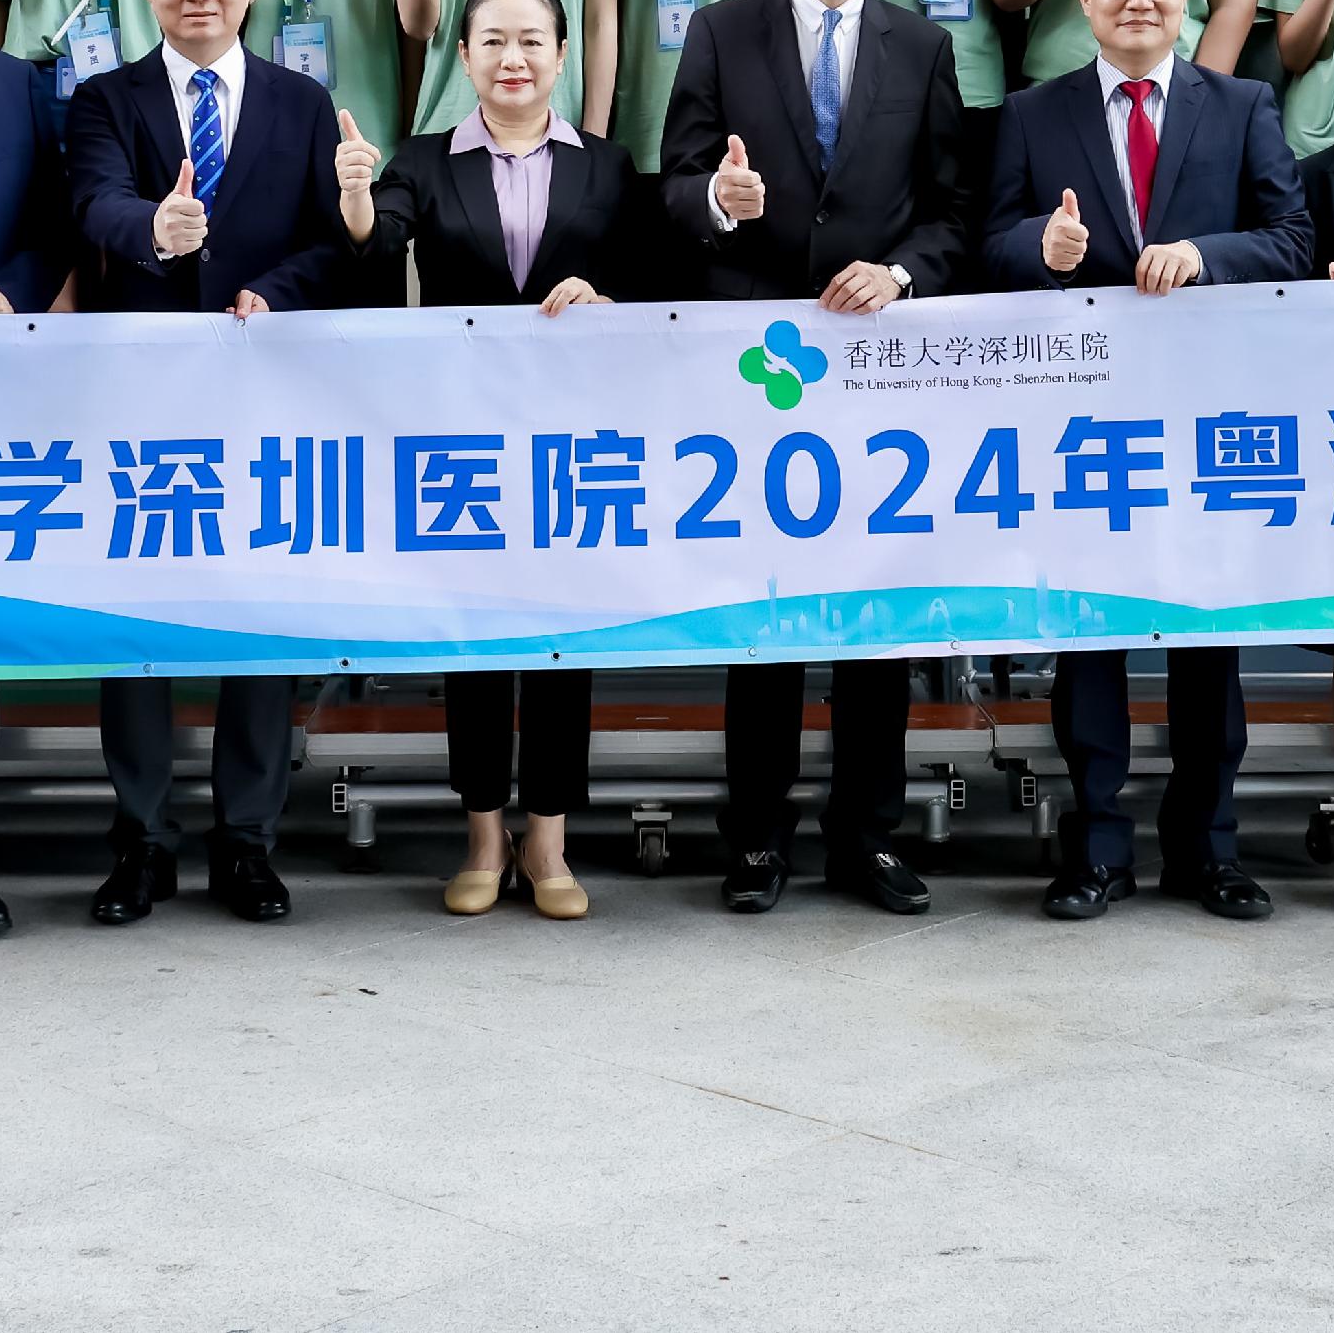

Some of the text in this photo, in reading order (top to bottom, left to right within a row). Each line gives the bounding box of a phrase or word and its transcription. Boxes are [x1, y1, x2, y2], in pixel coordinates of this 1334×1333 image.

[844, 332, 1109, 369] 香港大学深圳医院
[843, 379, 864, 390] The
[867, 378, 922, 391] University
[925, 377, 939, 388] of
[941, 376, 970, 389] Hong
[973, 375, 1003, 388] Kong
[1014, 373, 1065, 385] Shenzhen
[1068, 371, 1110, 385] Hospital
